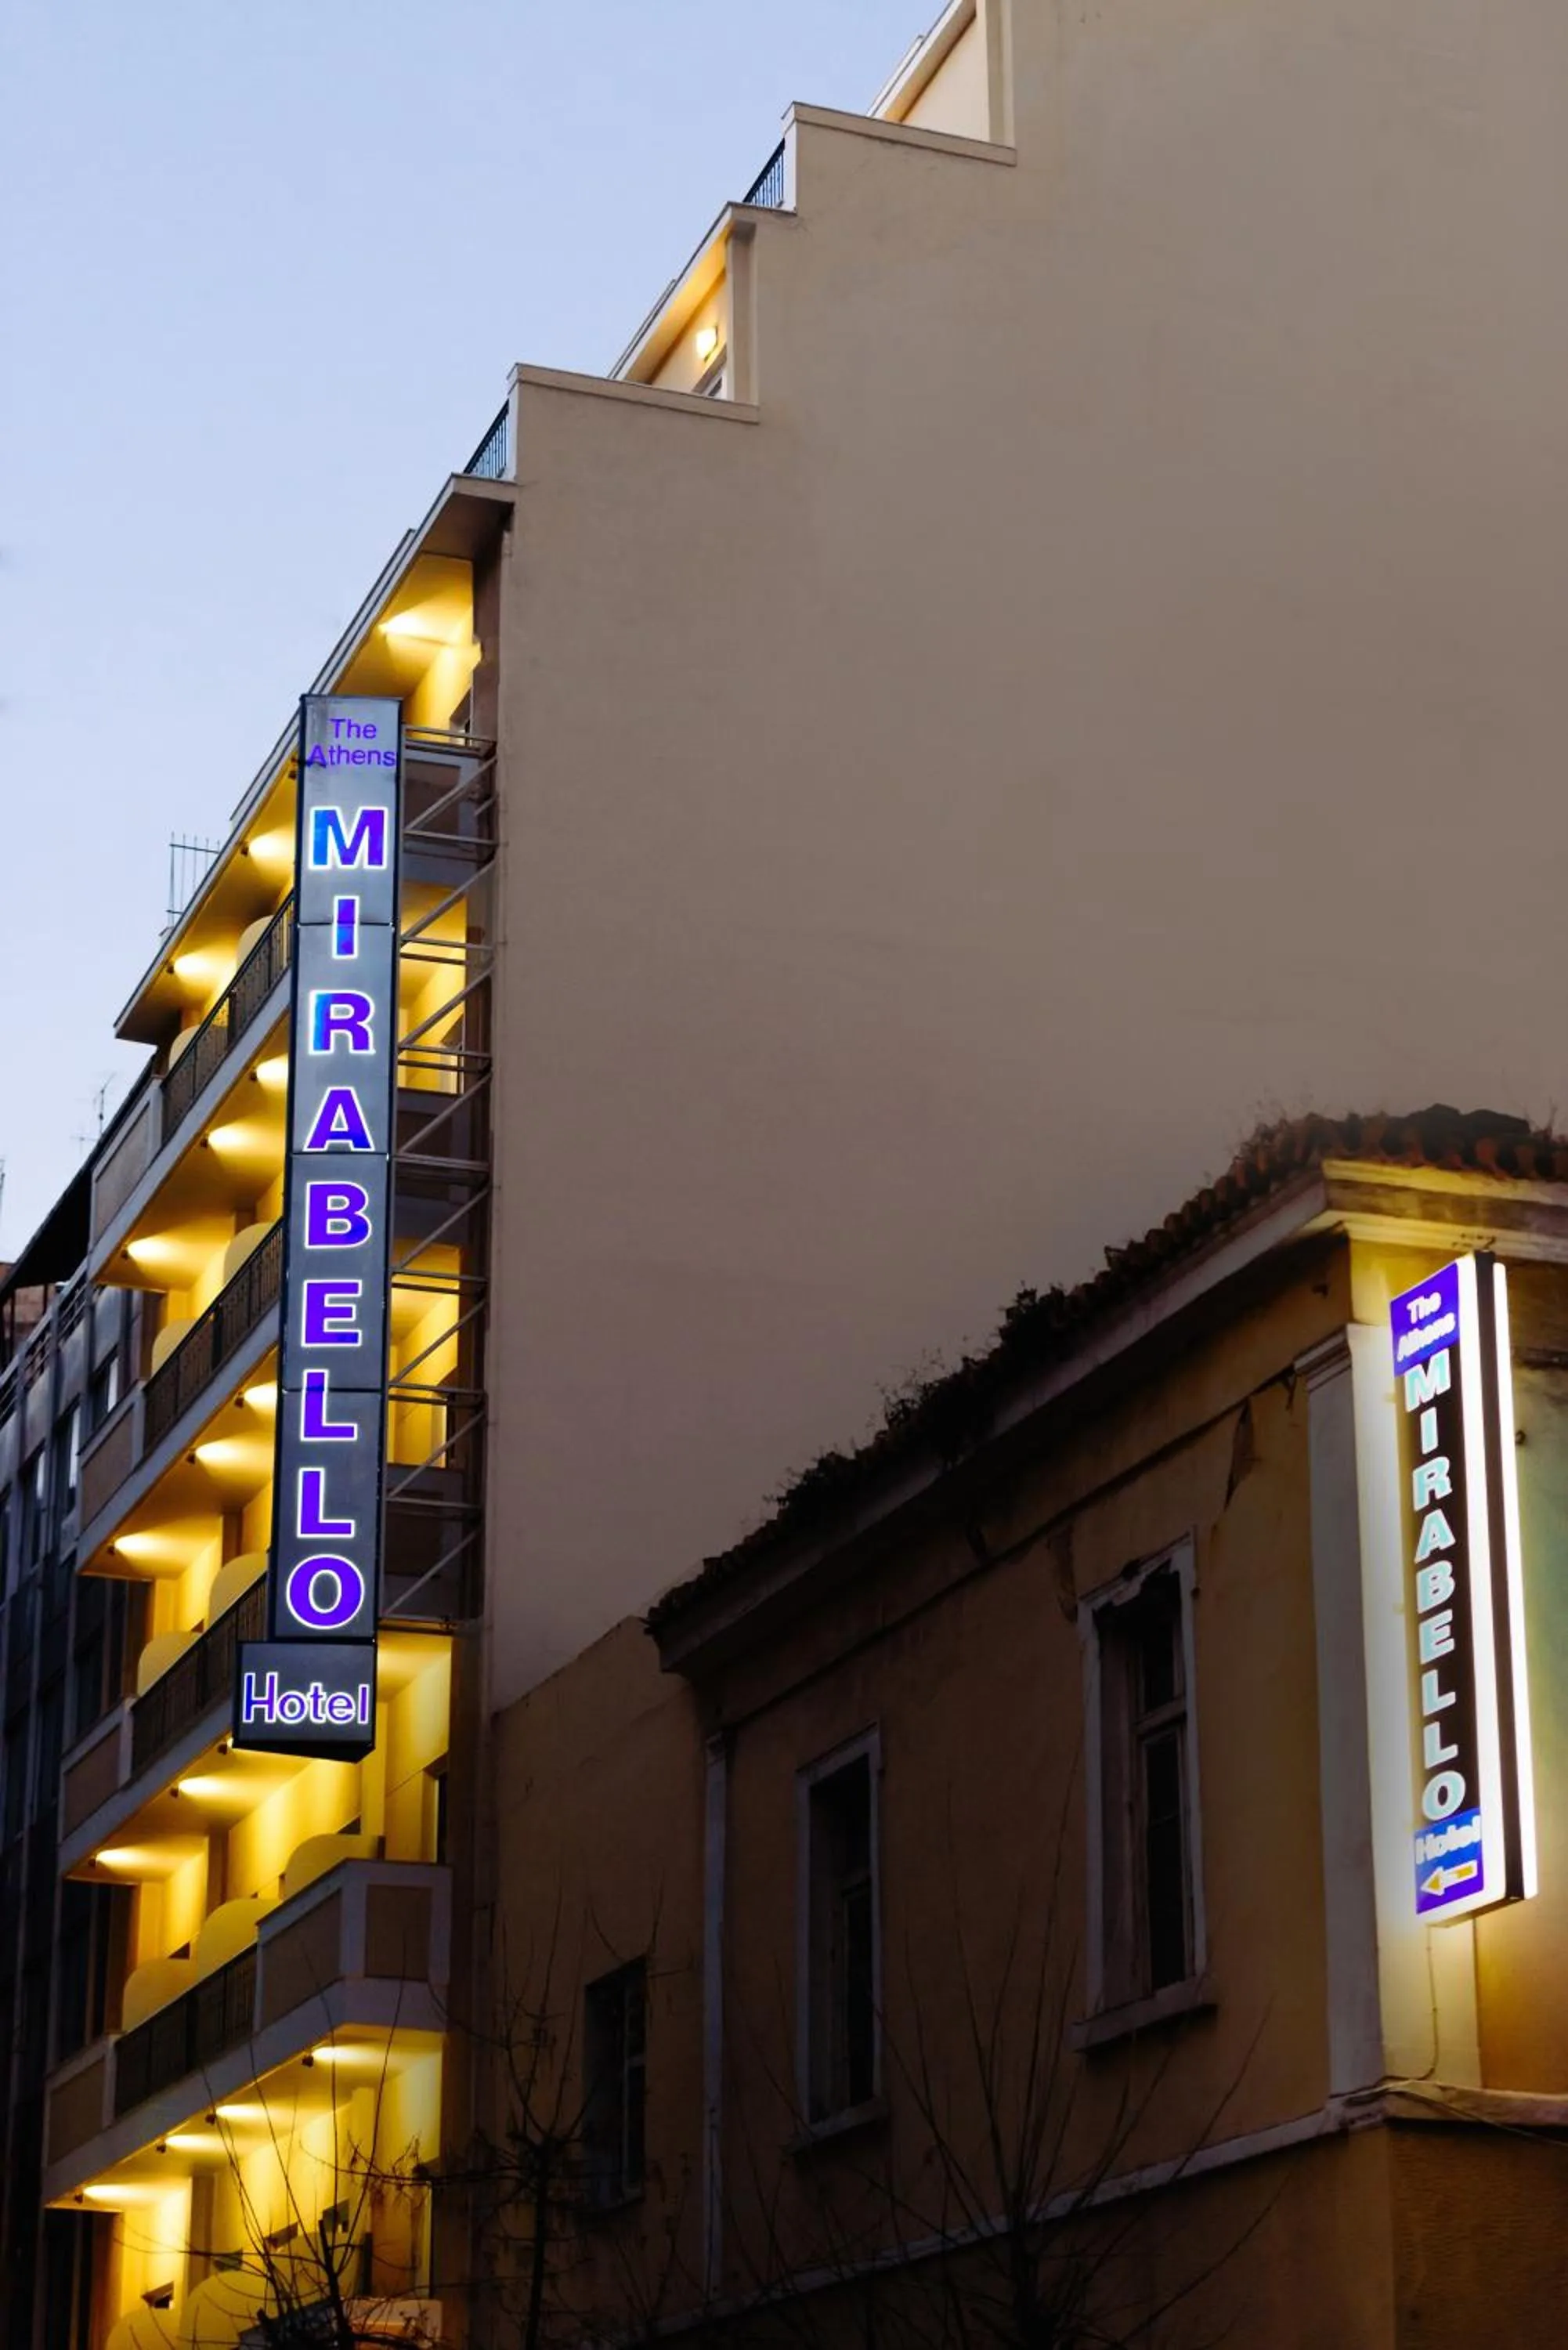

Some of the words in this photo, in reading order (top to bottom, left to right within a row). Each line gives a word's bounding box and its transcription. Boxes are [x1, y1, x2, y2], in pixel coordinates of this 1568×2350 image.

[330, 718, 377, 739] The
[306, 744, 396, 768] Athens
[286, 806, 388, 1629] MIRABELLO
[1404, 1348, 1465, 1820] MIRABELLO
[243, 1672, 370, 1725] Hotel
